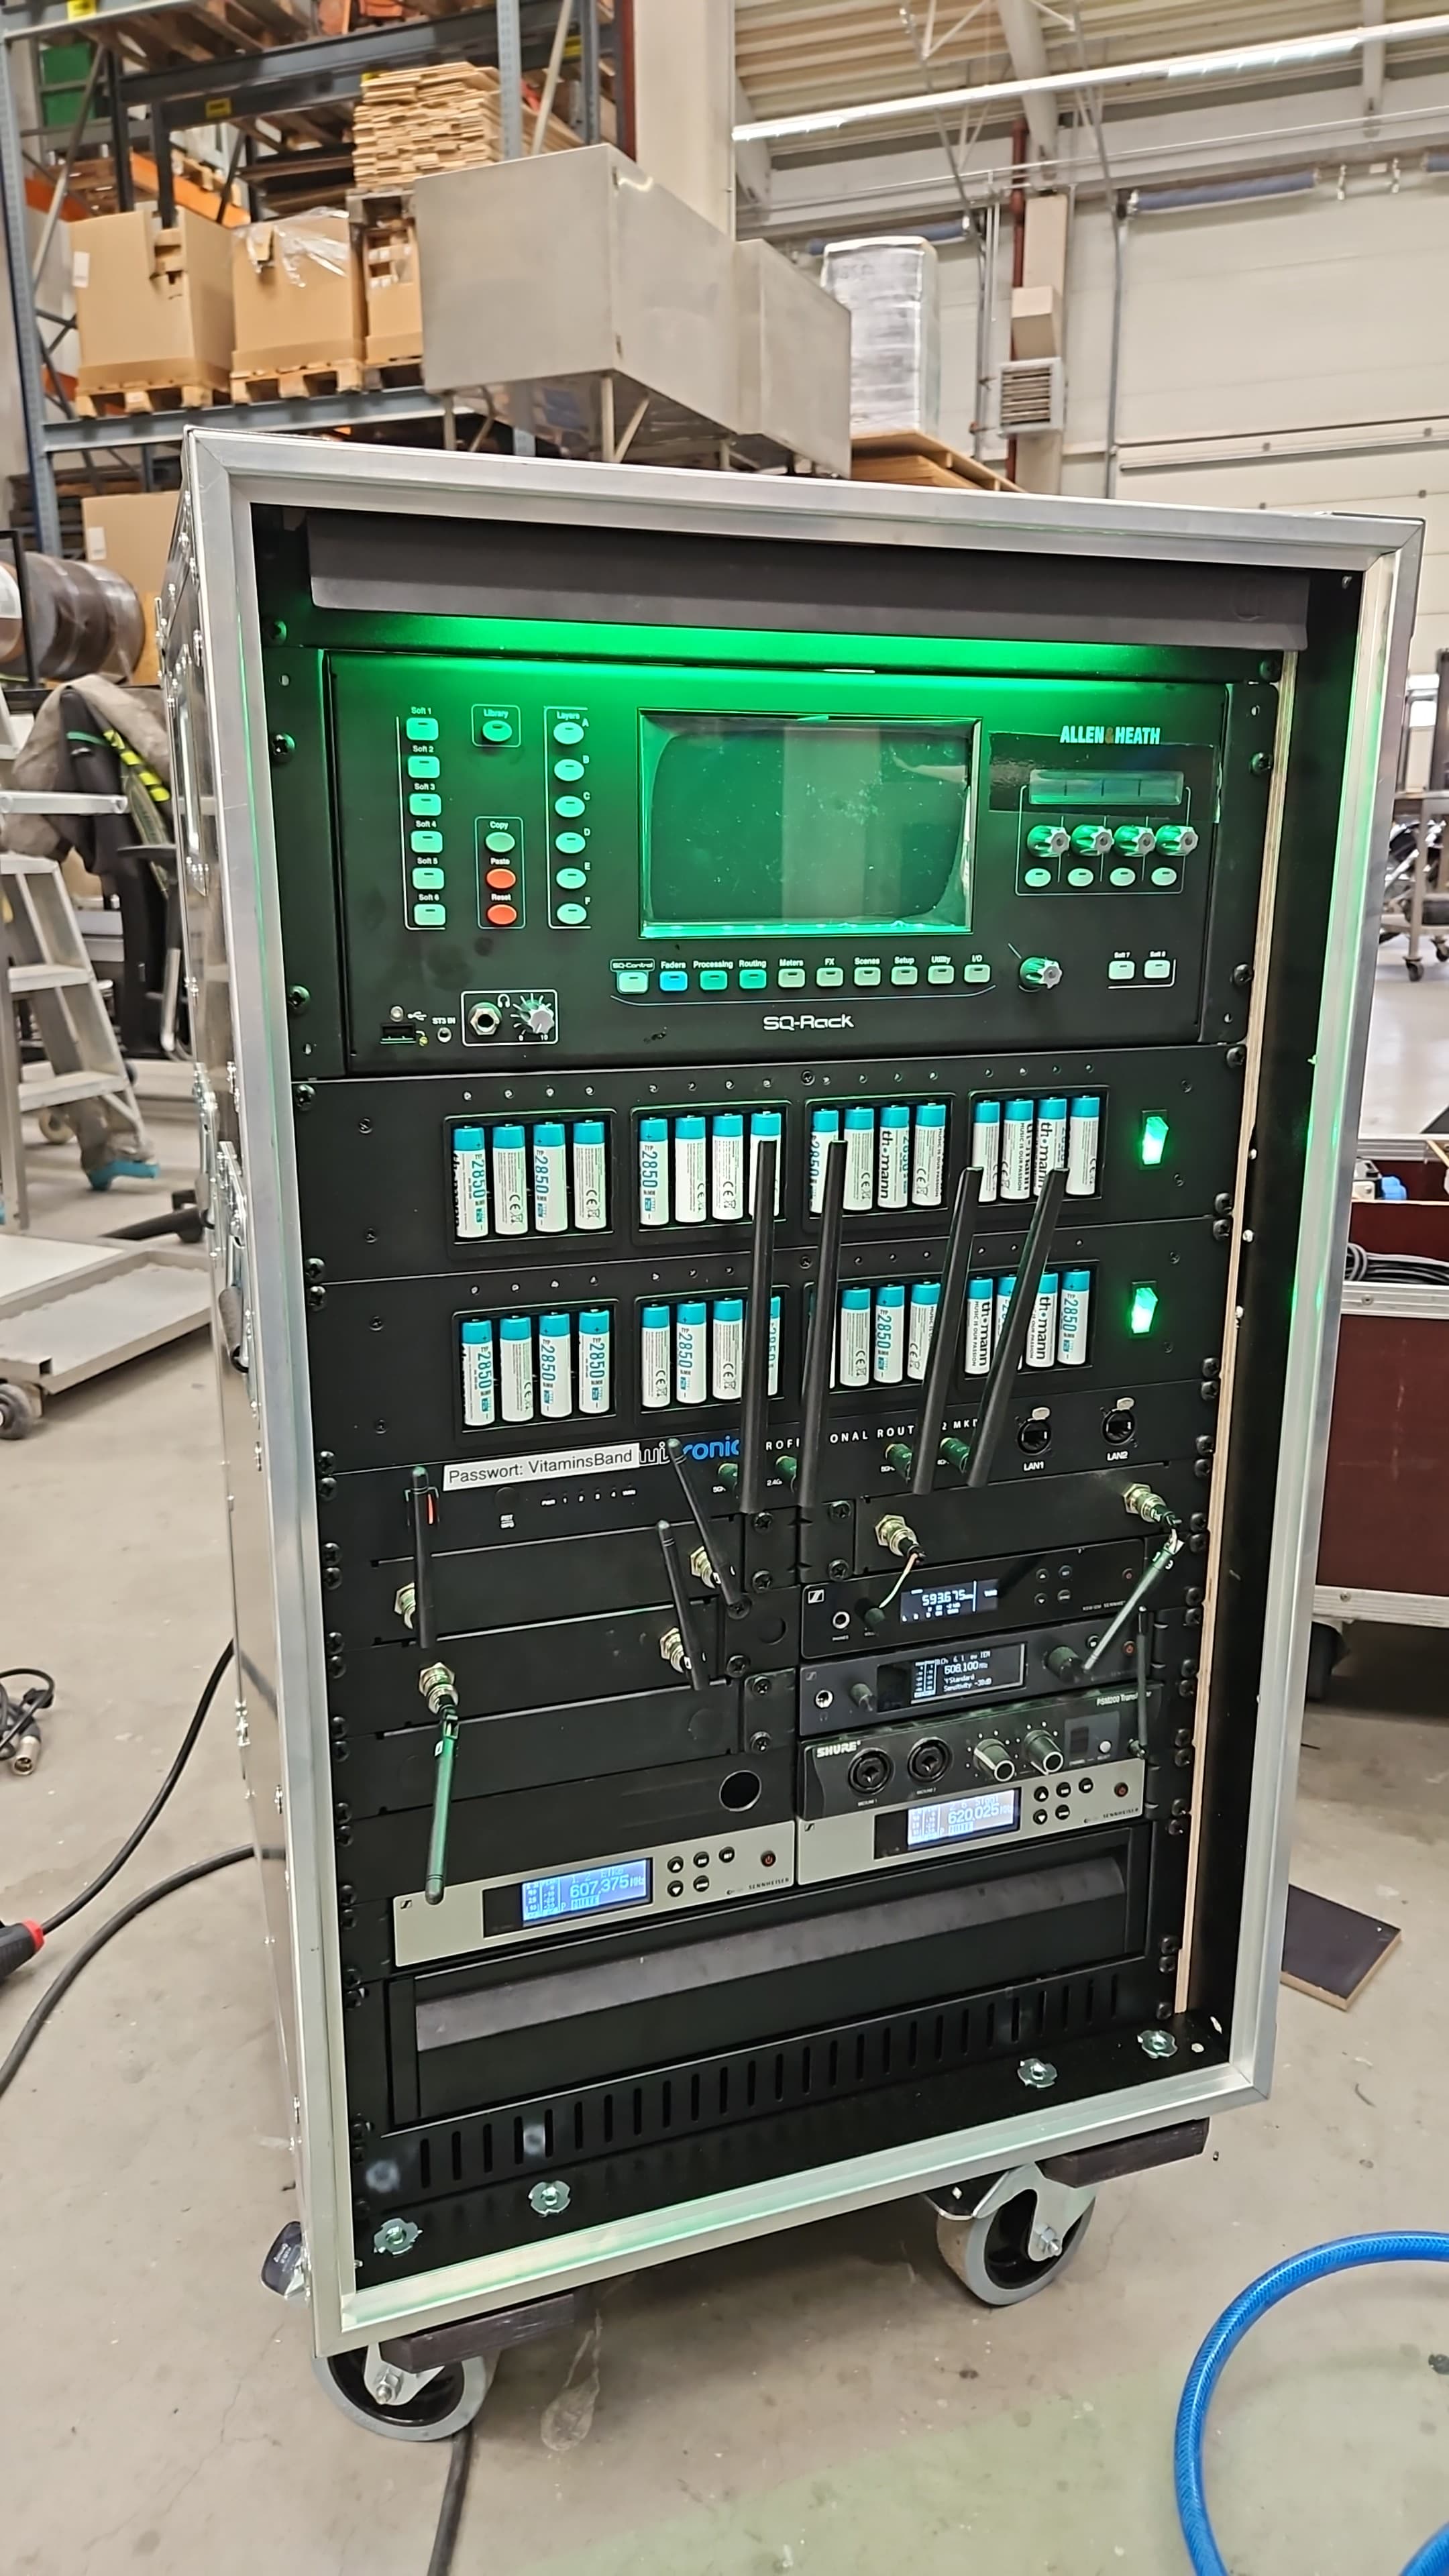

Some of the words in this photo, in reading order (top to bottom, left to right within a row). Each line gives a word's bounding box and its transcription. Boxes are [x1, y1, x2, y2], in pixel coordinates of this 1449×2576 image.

[411, 706, 425, 715] Soft
[428, 706, 432, 714] 1
[483, 708, 508, 719] Library
[557, 711, 580, 722] Layers
[582, 719, 589, 727] A
[413, 745, 427, 753] Soft
[429, 745, 434, 753] 2
[582, 755, 589, 763] B
[415, 783, 429, 791] Soft
[430, 783, 435, 791] 3
[583, 792, 590, 800] C
[490, 821, 508, 830] Copy
[584, 828, 590, 837] D
[417, 857, 432, 865] Soft
[433, 857, 438, 865] 5
[490, 857, 510, 865] Paste
[584, 862, 590, 871] E
[419, 894, 433, 902] Soft
[433, 894, 439, 902] 6
[491, 894, 511, 902] Reset
[693, 961, 734, 969] Processing
[739, 959, 767, 968] Routing
[779, 958, 804, 967] Meters
[825, 958, 835, 966] FX
[854, 957, 880, 965] Scenes
[894, 957, 915, 966] Setup
[931, 955, 951, 965] Utility
[763, 1014, 855, 1030] SQ-Rack
[535, 1156, 549, 1194] 2850
[642, 1151, 658, 1189] 2850
[472, 1159, 486, 1198] 2850
[1063, 1299, 1079, 1332] 2850
[877, 1314, 892, 1349] 2850
[679, 1332, 692, 1368] 2850
[541, 1345, 555, 1381] 2850
[589, 1343, 605, 1378] 2850
[478, 1352, 492, 1389] 2850
[877, 1425, 915, 1438] ROUT
[1107, 1450, 1128, 1461] LAN2
[449, 1463, 524, 1484] Passwort:
[527, 1450, 633, 1474] VitaminsBand
[1024, 1461, 1044, 1471] LAN1
[817, 1743, 857, 1758] SHURE
[570, 1874, 629, 1898] 607.375
[749, 1877, 789, 1890] SENNHEISER
